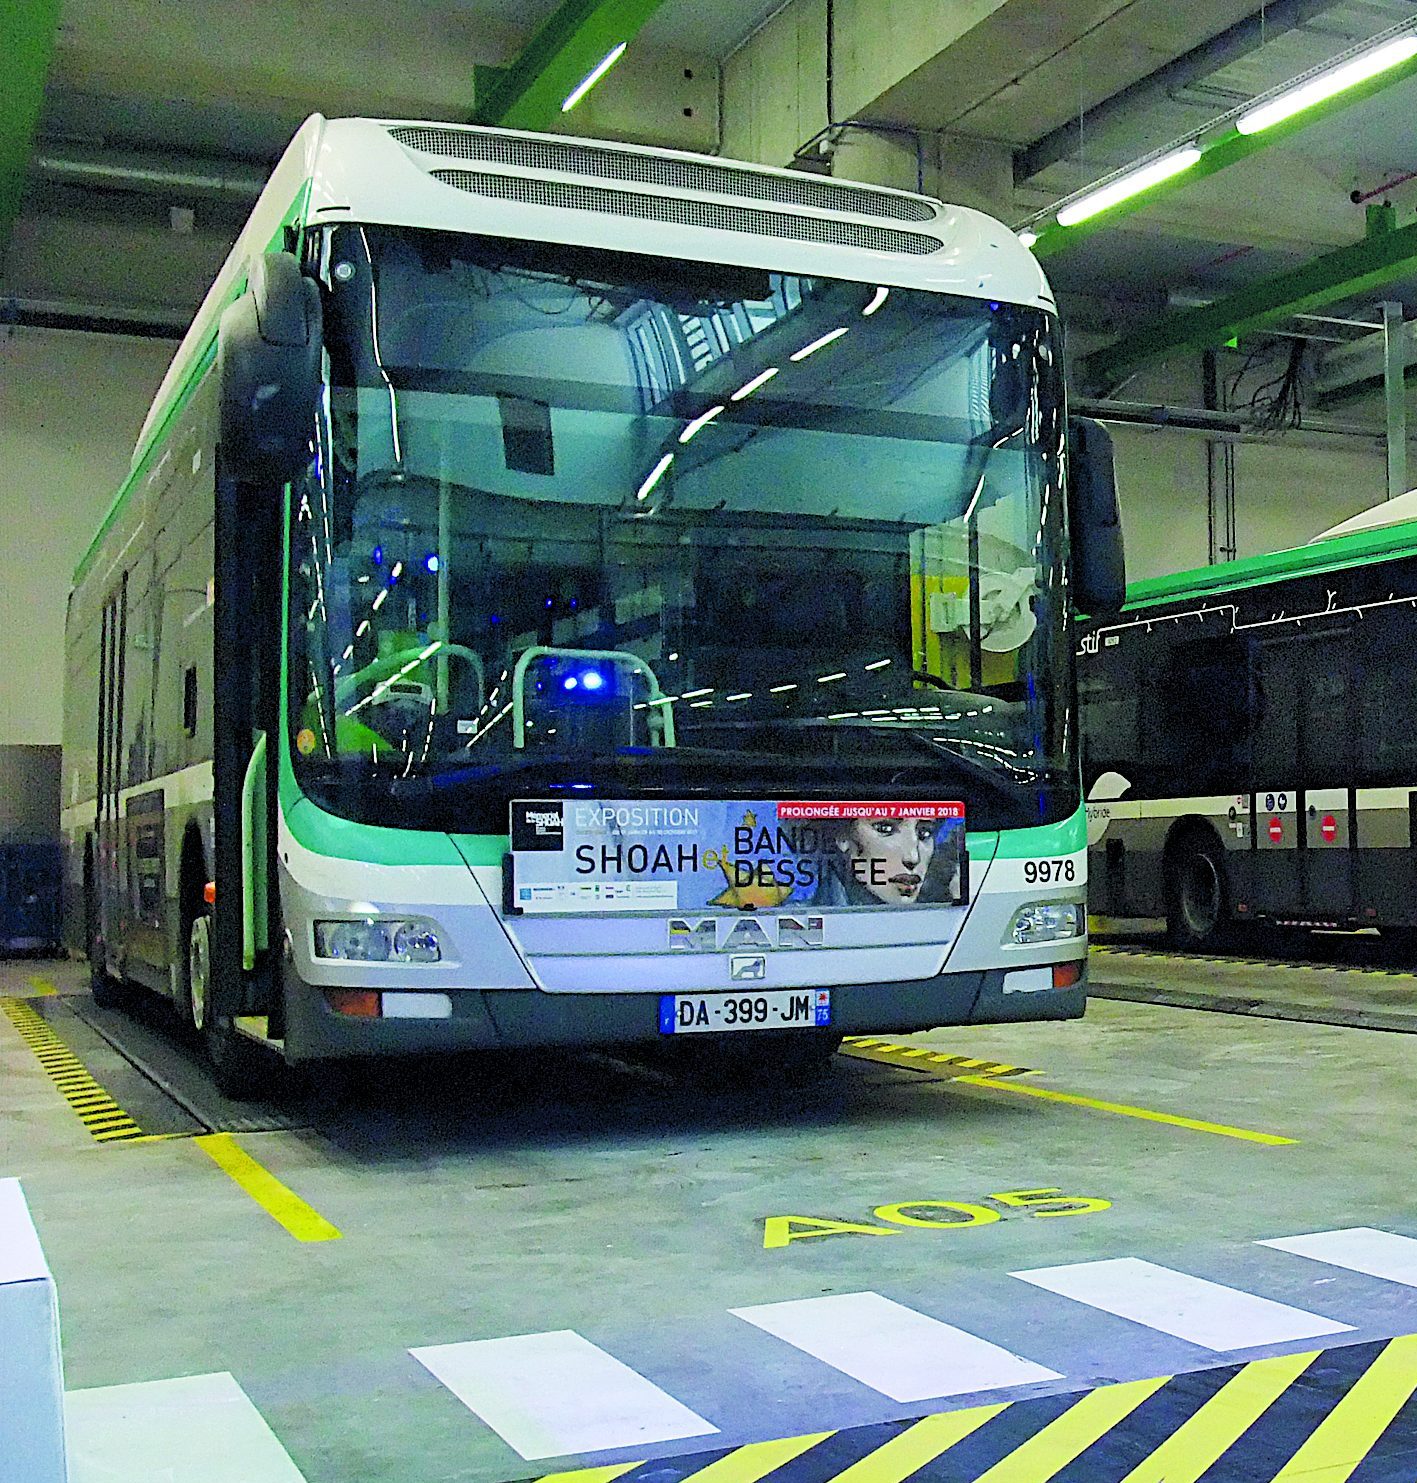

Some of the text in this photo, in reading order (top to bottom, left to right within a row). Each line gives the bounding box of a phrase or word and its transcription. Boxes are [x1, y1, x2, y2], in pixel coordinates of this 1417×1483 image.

[1076, 630, 1101, 656] stif
[575, 807, 699, 828] EXPOSITION
[780, 805, 959, 817] PROLONGÉE JUSQU'AU 7 JANVIER 2018
[733, 826, 837, 855] BANDE
[575, 843, 730, 875] SHOAH et
[1023, 859, 1076, 884] 9978
[667, 915, 824, 950] MAN
[679, 995, 810, 1027] DA-399-JM
[817, 1009, 830, 1021] 75
